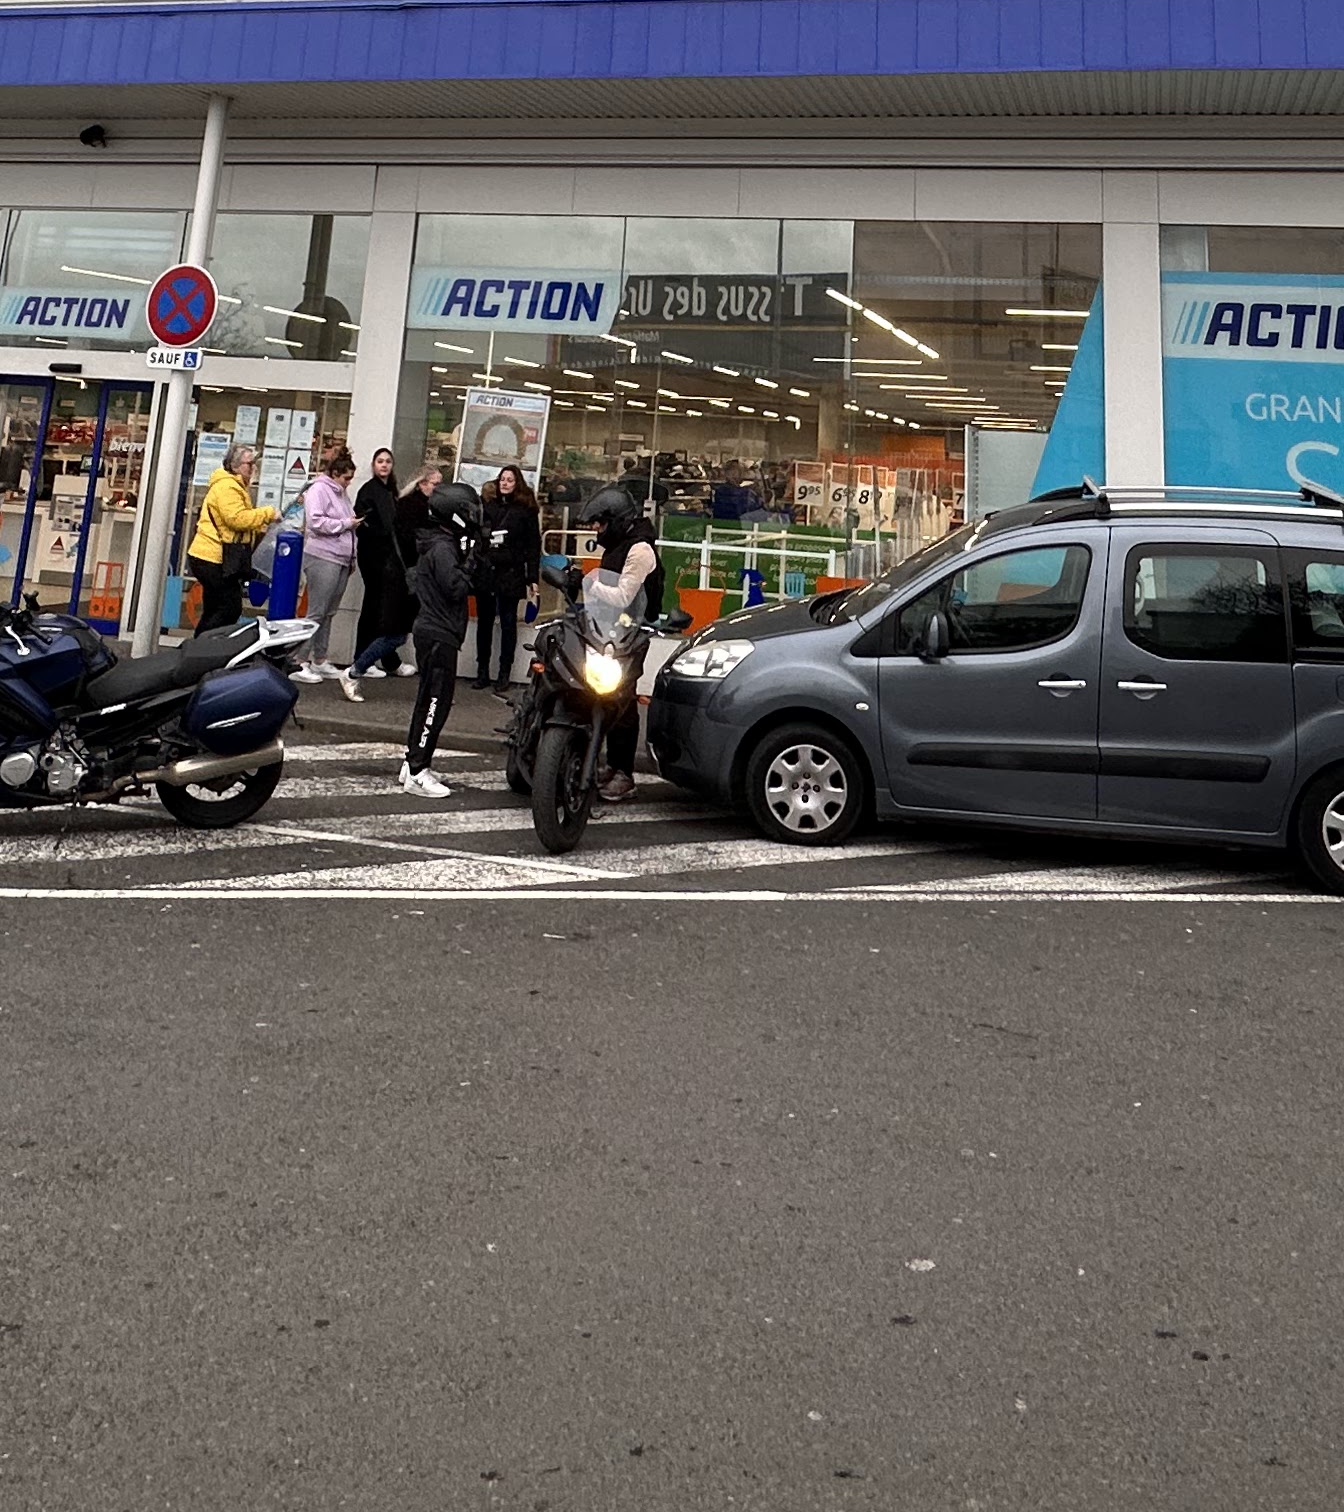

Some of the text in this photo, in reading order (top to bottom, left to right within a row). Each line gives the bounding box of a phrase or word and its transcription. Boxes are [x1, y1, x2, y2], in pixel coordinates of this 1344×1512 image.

[15, 296, 131, 329] ACTION
[440, 278, 605, 322] ACTION
[149, 351, 181, 365] SAUF
[476, 394, 514, 407] ACTION
[418, 697, 438, 748] NIKE AIR
